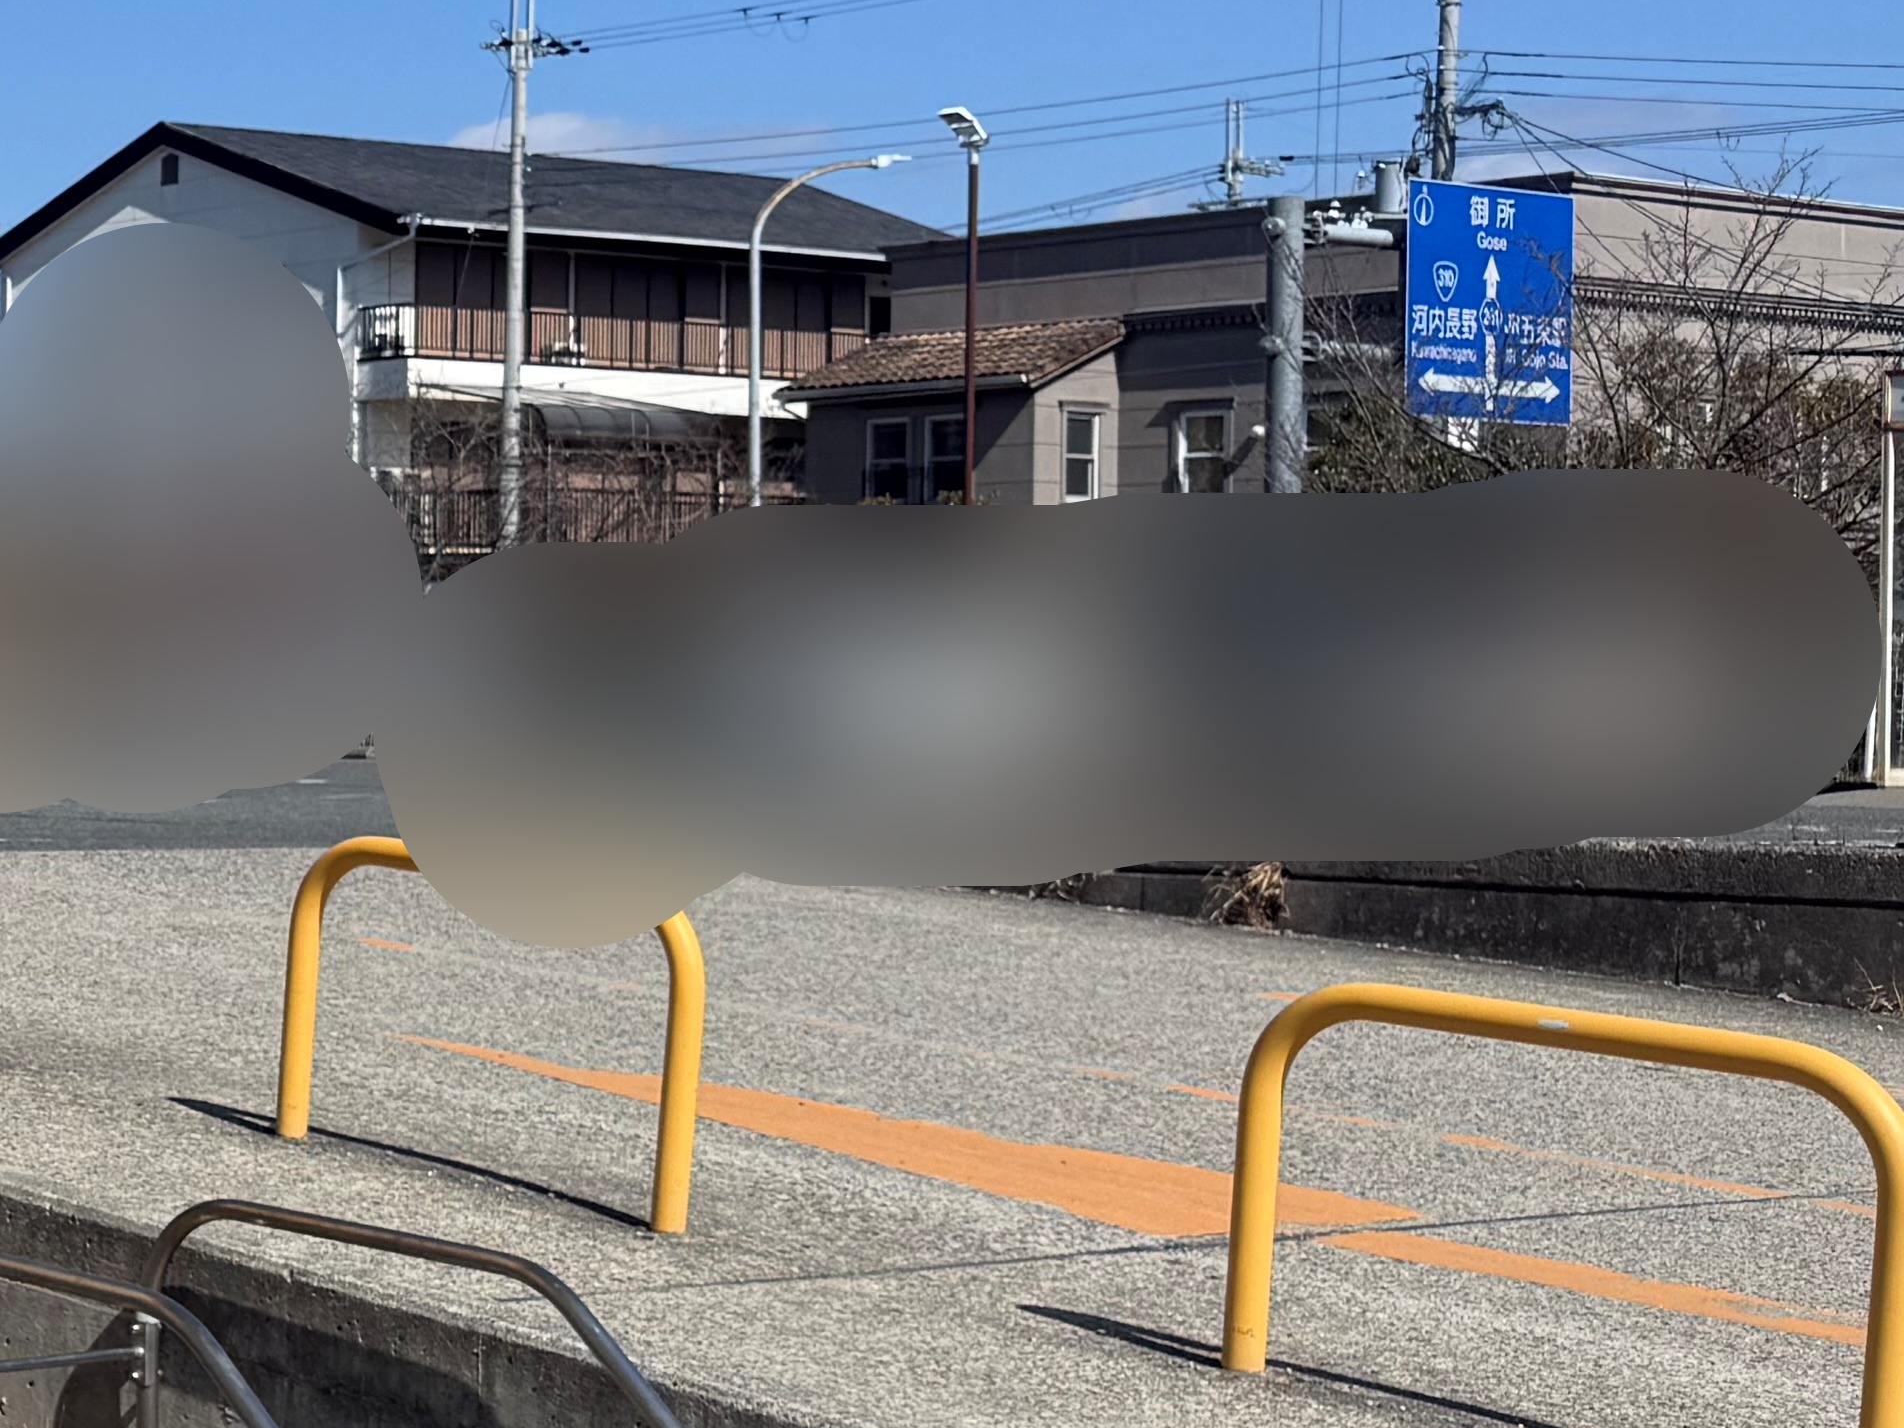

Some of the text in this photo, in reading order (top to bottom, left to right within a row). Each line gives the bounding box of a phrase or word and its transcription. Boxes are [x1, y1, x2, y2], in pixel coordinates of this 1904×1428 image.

[1469, 195, 1516, 230] 御所
[1476, 232, 1507, 251] Gose
[1438, 268, 1454, 288] 310
[1411, 304, 1478, 341] 河内長野
